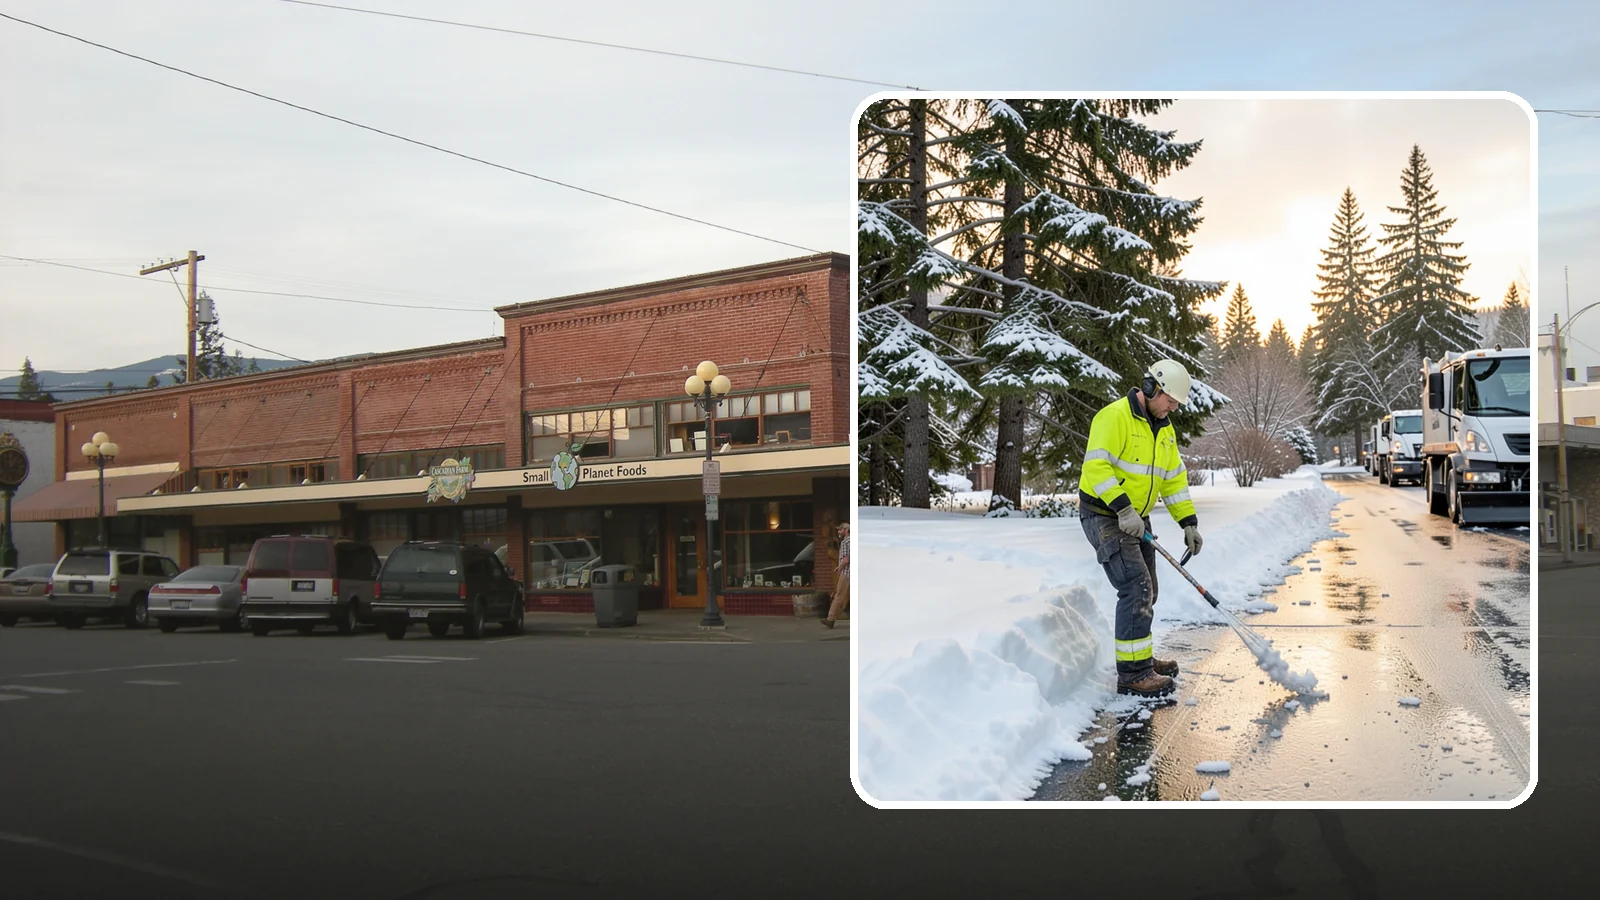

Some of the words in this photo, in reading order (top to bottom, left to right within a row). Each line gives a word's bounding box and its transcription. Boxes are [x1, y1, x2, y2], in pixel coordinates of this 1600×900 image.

[523, 471, 549, 483] Small
[583, 468, 614, 479] Planet
[617, 464, 647, 477] Foods
